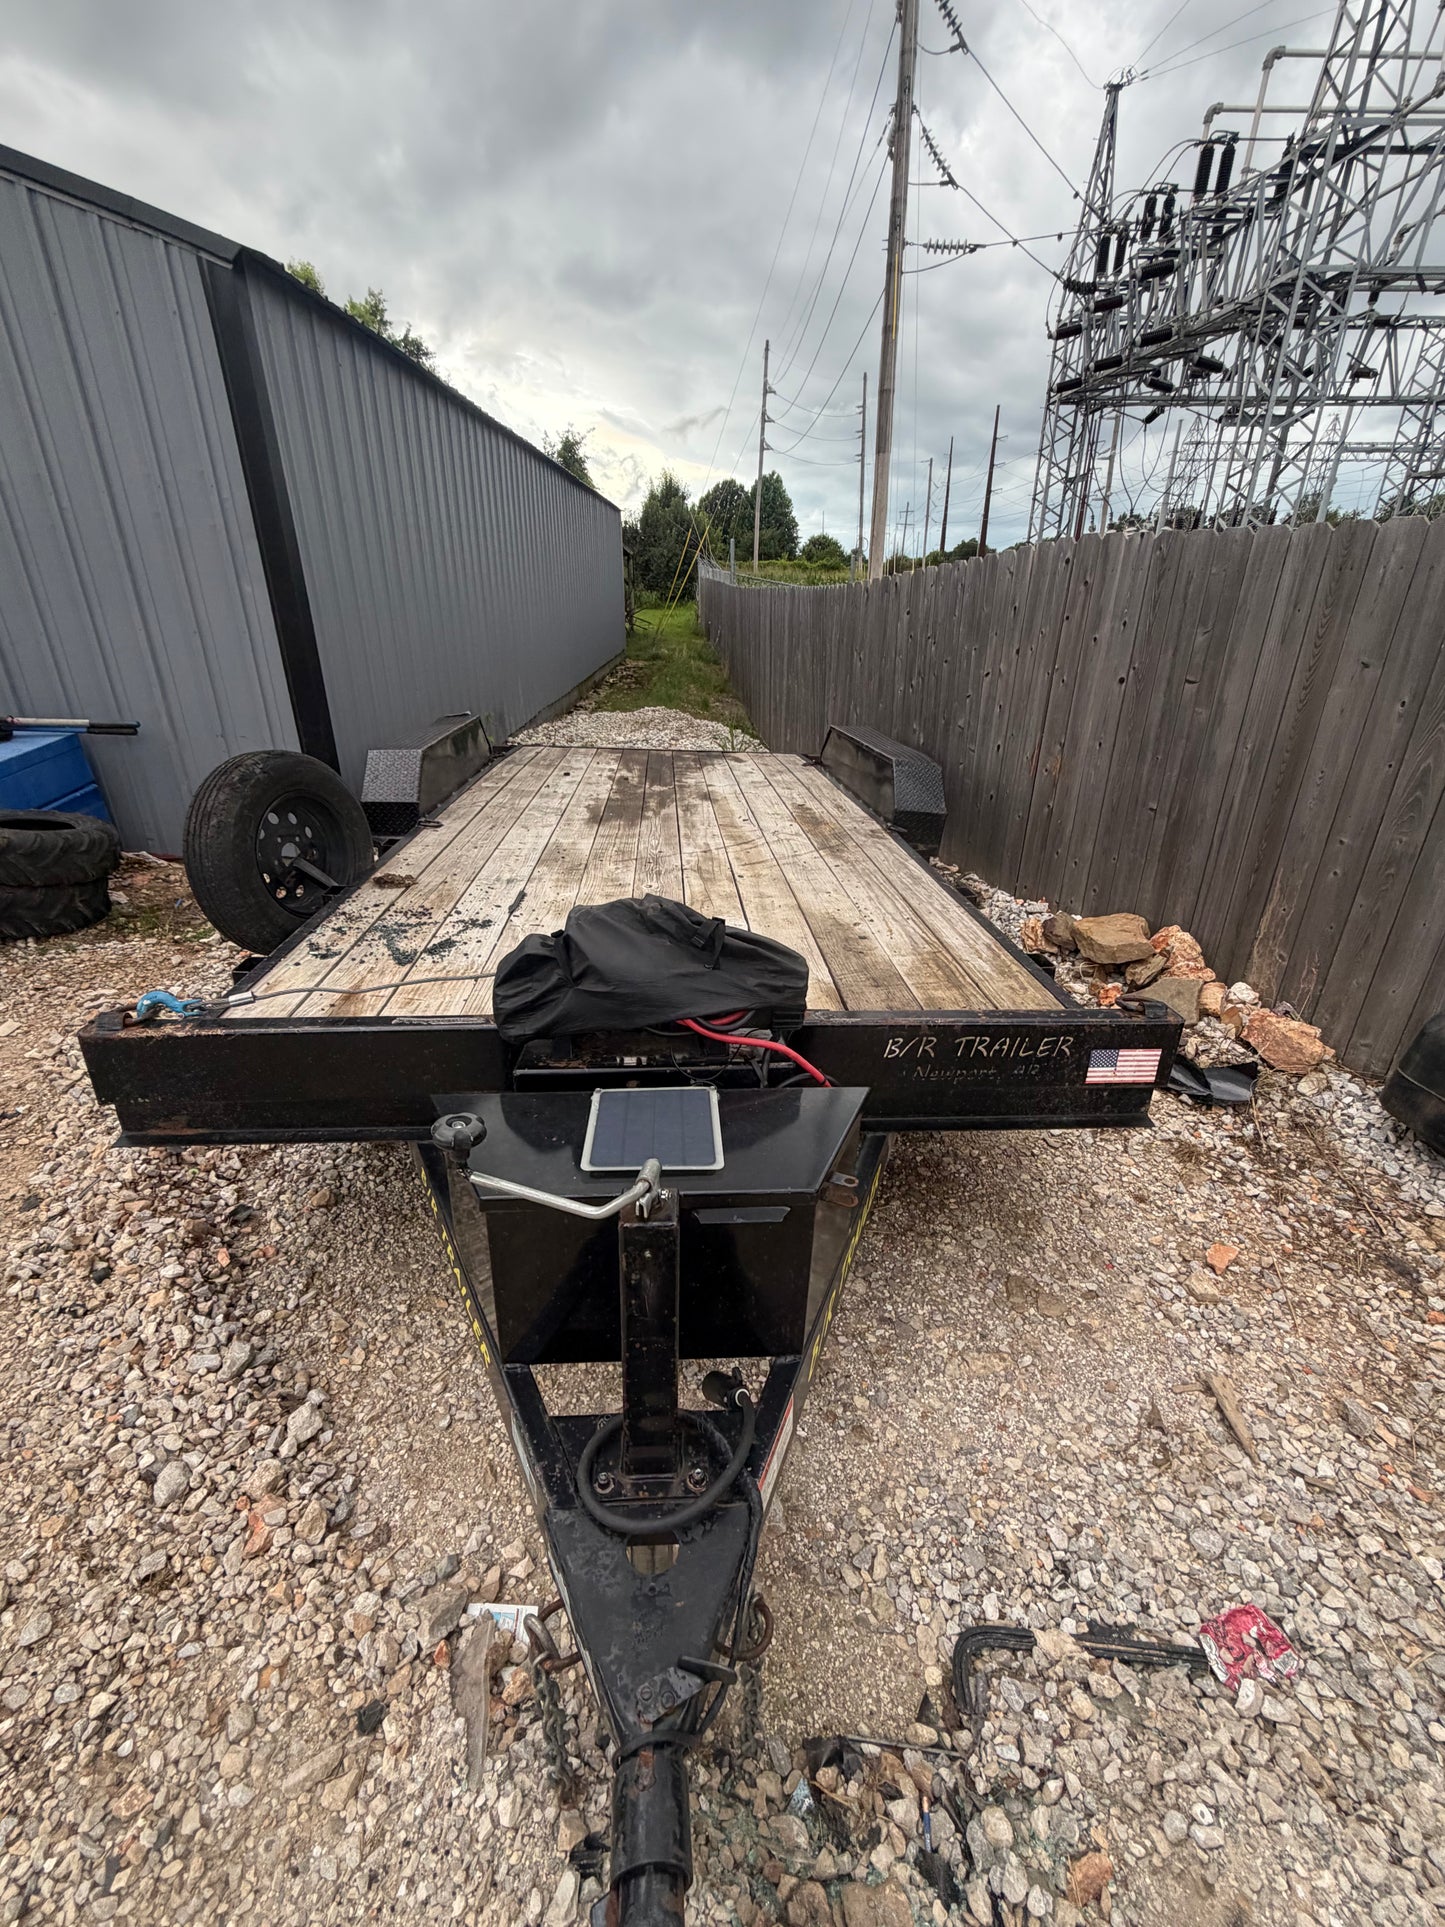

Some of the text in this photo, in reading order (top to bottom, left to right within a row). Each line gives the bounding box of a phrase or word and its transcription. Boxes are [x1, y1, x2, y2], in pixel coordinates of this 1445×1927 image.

[883, 1036, 1075, 1058] B/R TRAILER
[441, 1224, 491, 1369] TRAILER
